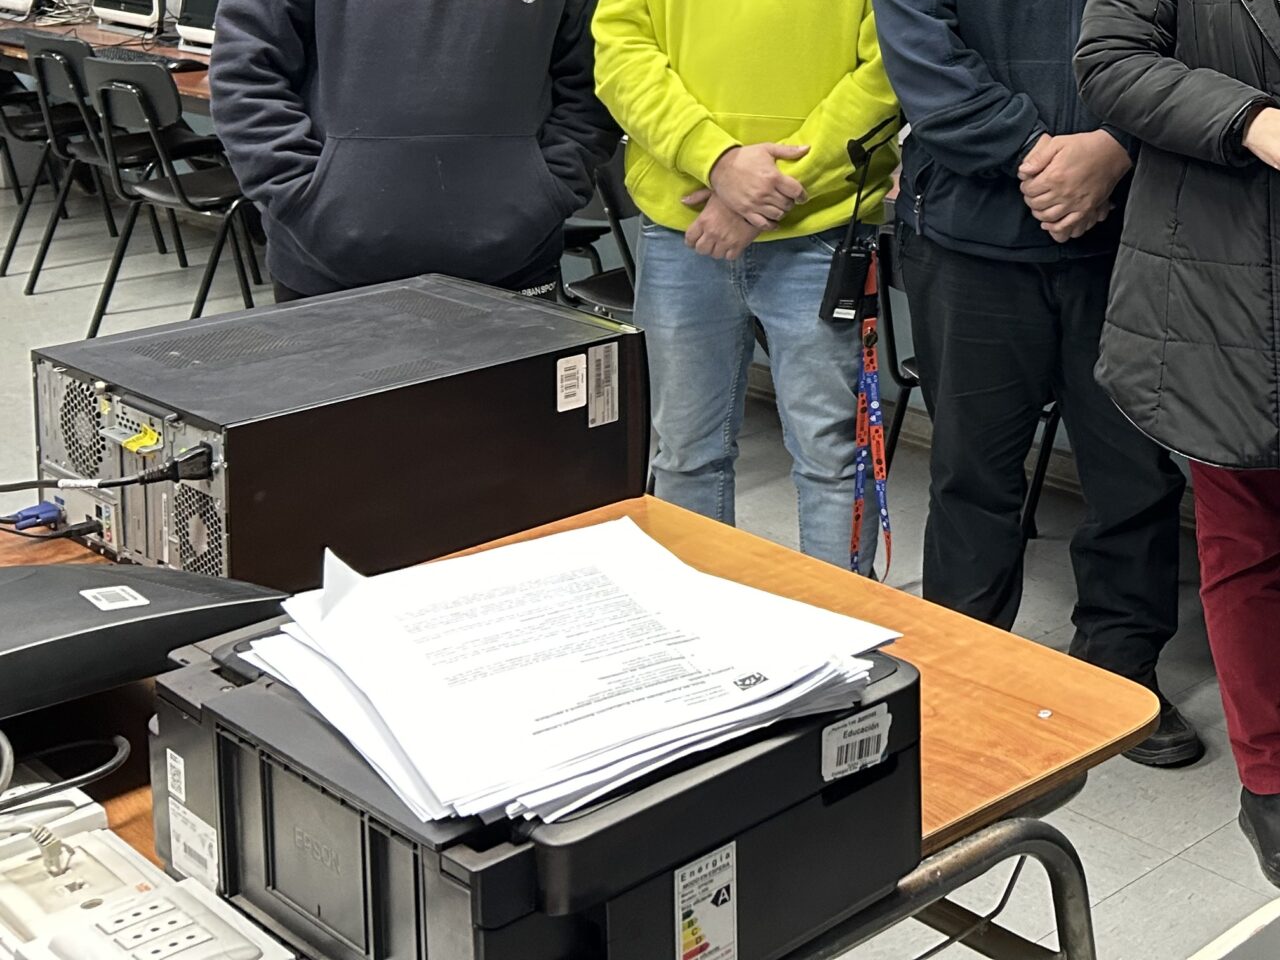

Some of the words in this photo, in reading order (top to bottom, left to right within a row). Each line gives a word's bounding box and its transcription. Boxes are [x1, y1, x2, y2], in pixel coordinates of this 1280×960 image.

[843, 722, 880, 739] Educación
[292, 824, 343, 876] EPSON
[718, 887, 730, 906] A
